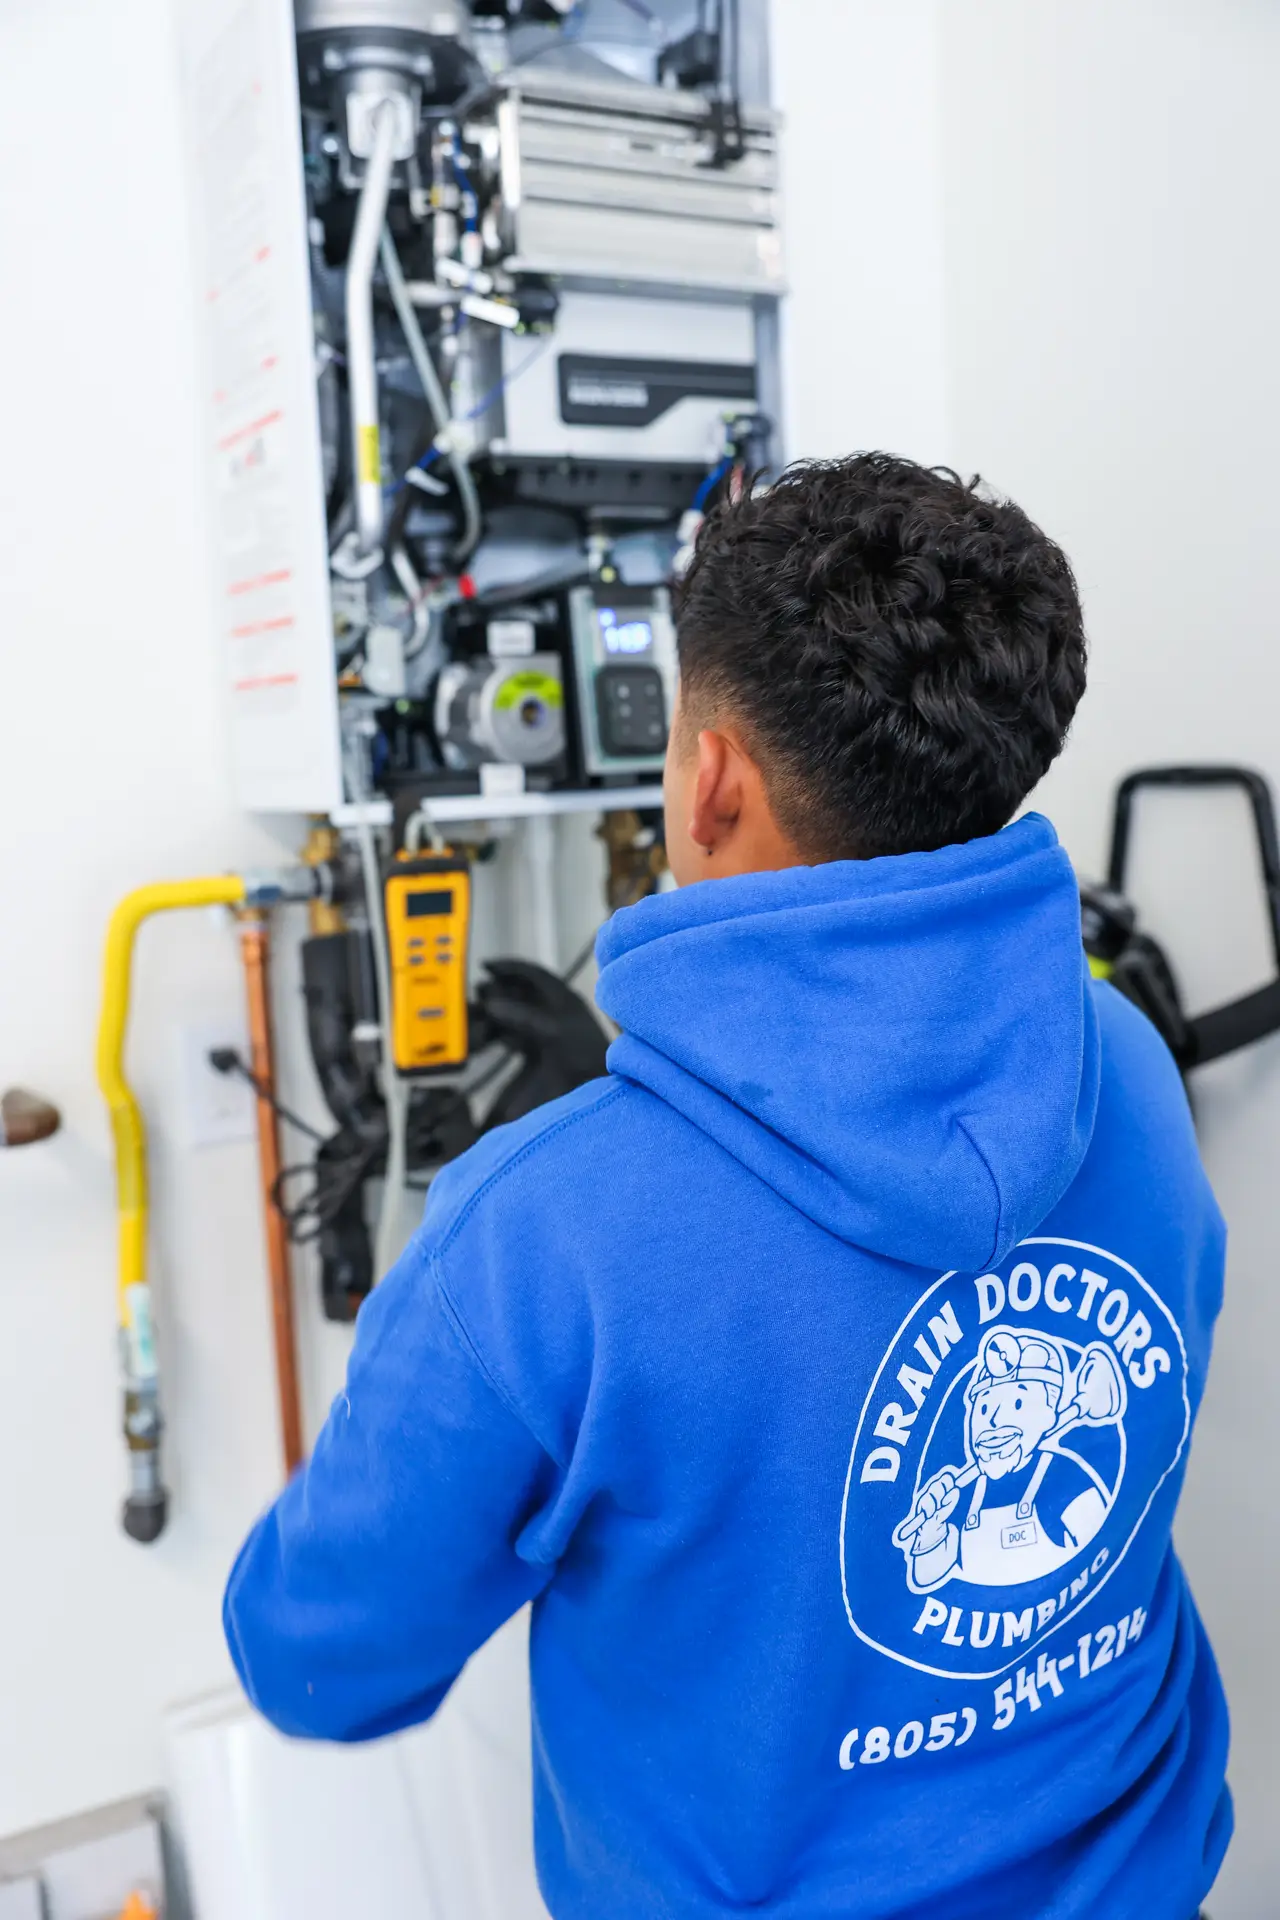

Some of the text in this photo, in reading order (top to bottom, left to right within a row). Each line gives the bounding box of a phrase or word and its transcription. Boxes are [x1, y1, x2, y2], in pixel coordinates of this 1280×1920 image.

[860, 1263, 1171, 1484] DRAIN DOCTORS
[913, 1548, 1109, 1649] PLUMBING
[1008, 1529, 1027, 1544] DOC
[838, 1608, 1148, 1770] (805) 544-1214
